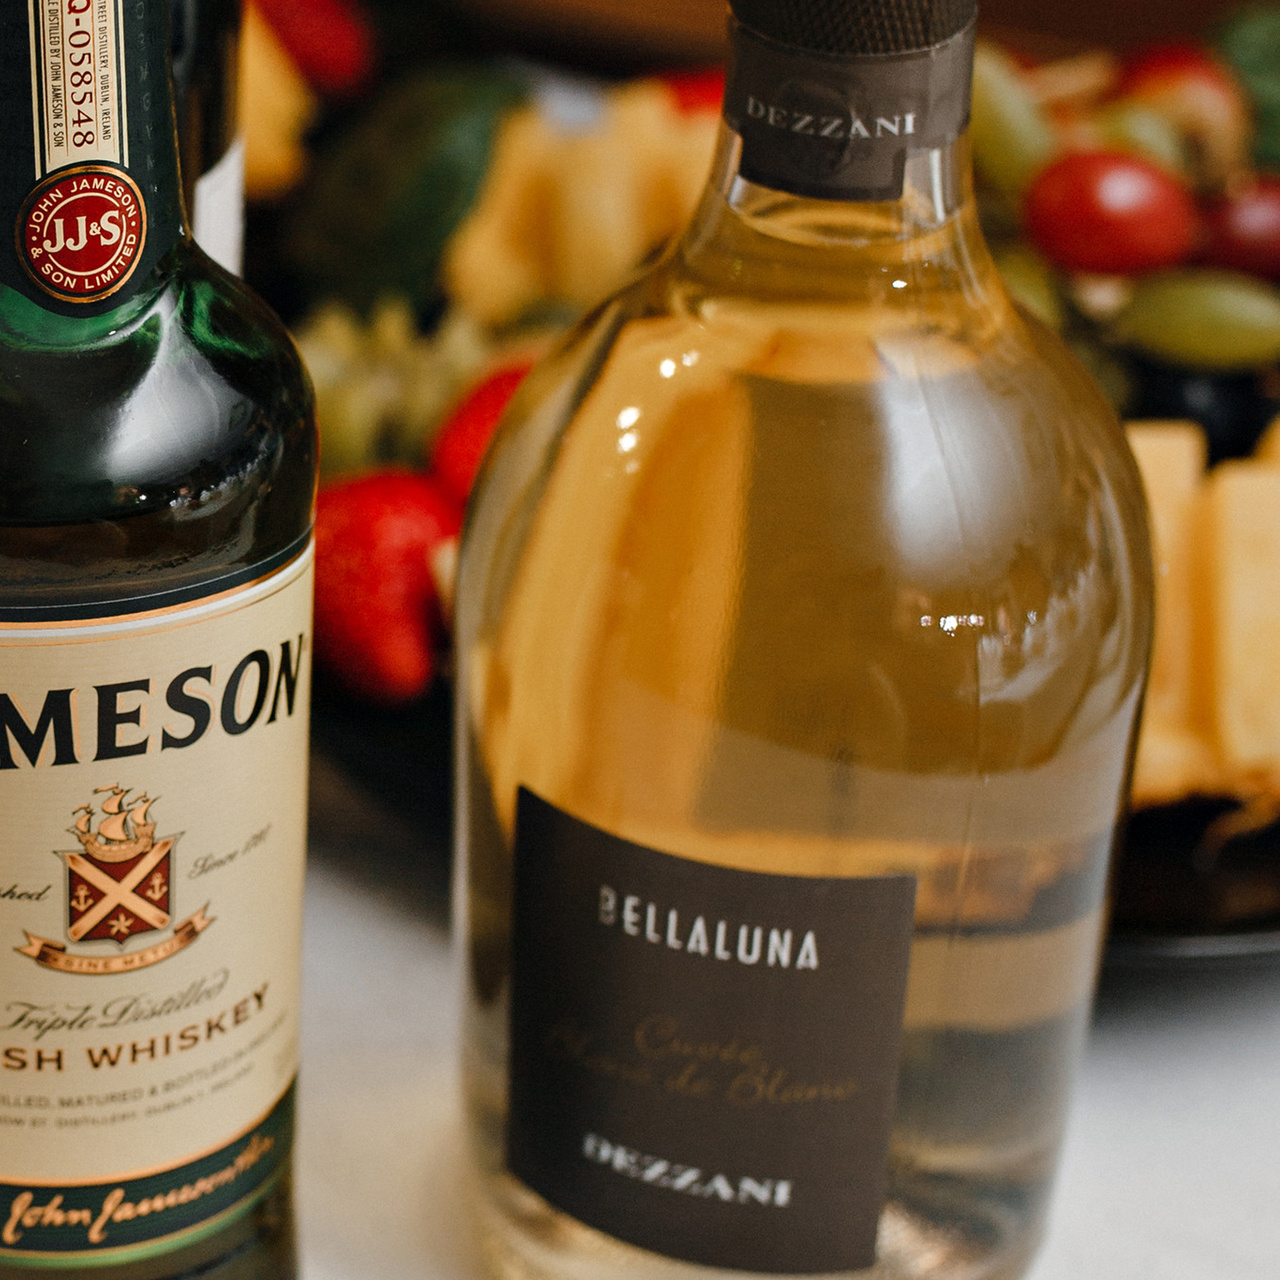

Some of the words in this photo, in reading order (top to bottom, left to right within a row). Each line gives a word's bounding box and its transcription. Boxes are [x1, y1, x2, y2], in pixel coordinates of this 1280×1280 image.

[47, 8, 60, 46] DISTILLED
[97, 26, 109, 72] DISTILLERY,
[49, 48, 61, 59] BY
[50, 60, 61, 82] JOHN
[51, 84, 63, 120] JAMESON
[100, 74, 110, 106] DUBLIN,
[53, 131, 64, 148] SON
[101, 108, 112, 141] IRELAND
[747, 96, 917, 140] DEZZANI
[29, 188, 64, 233] JOHN
[70, 178, 137, 218] JAMESON
[42, 209, 121, 253] JJ&S
[30, 247, 43, 259] &
[41, 262, 77, 289] SON
[84, 233, 137, 290] LIMITED
[600, 885, 819, 970] BELLALUNA
[64, 959, 111, 971] SINE
[98, 968, 230, 1028] Distilled
[87, 982, 270, 1070] WHISKEY
[582, 1132, 794, 1208] DEZZANI
[1, 1191, 92, 1245] John
